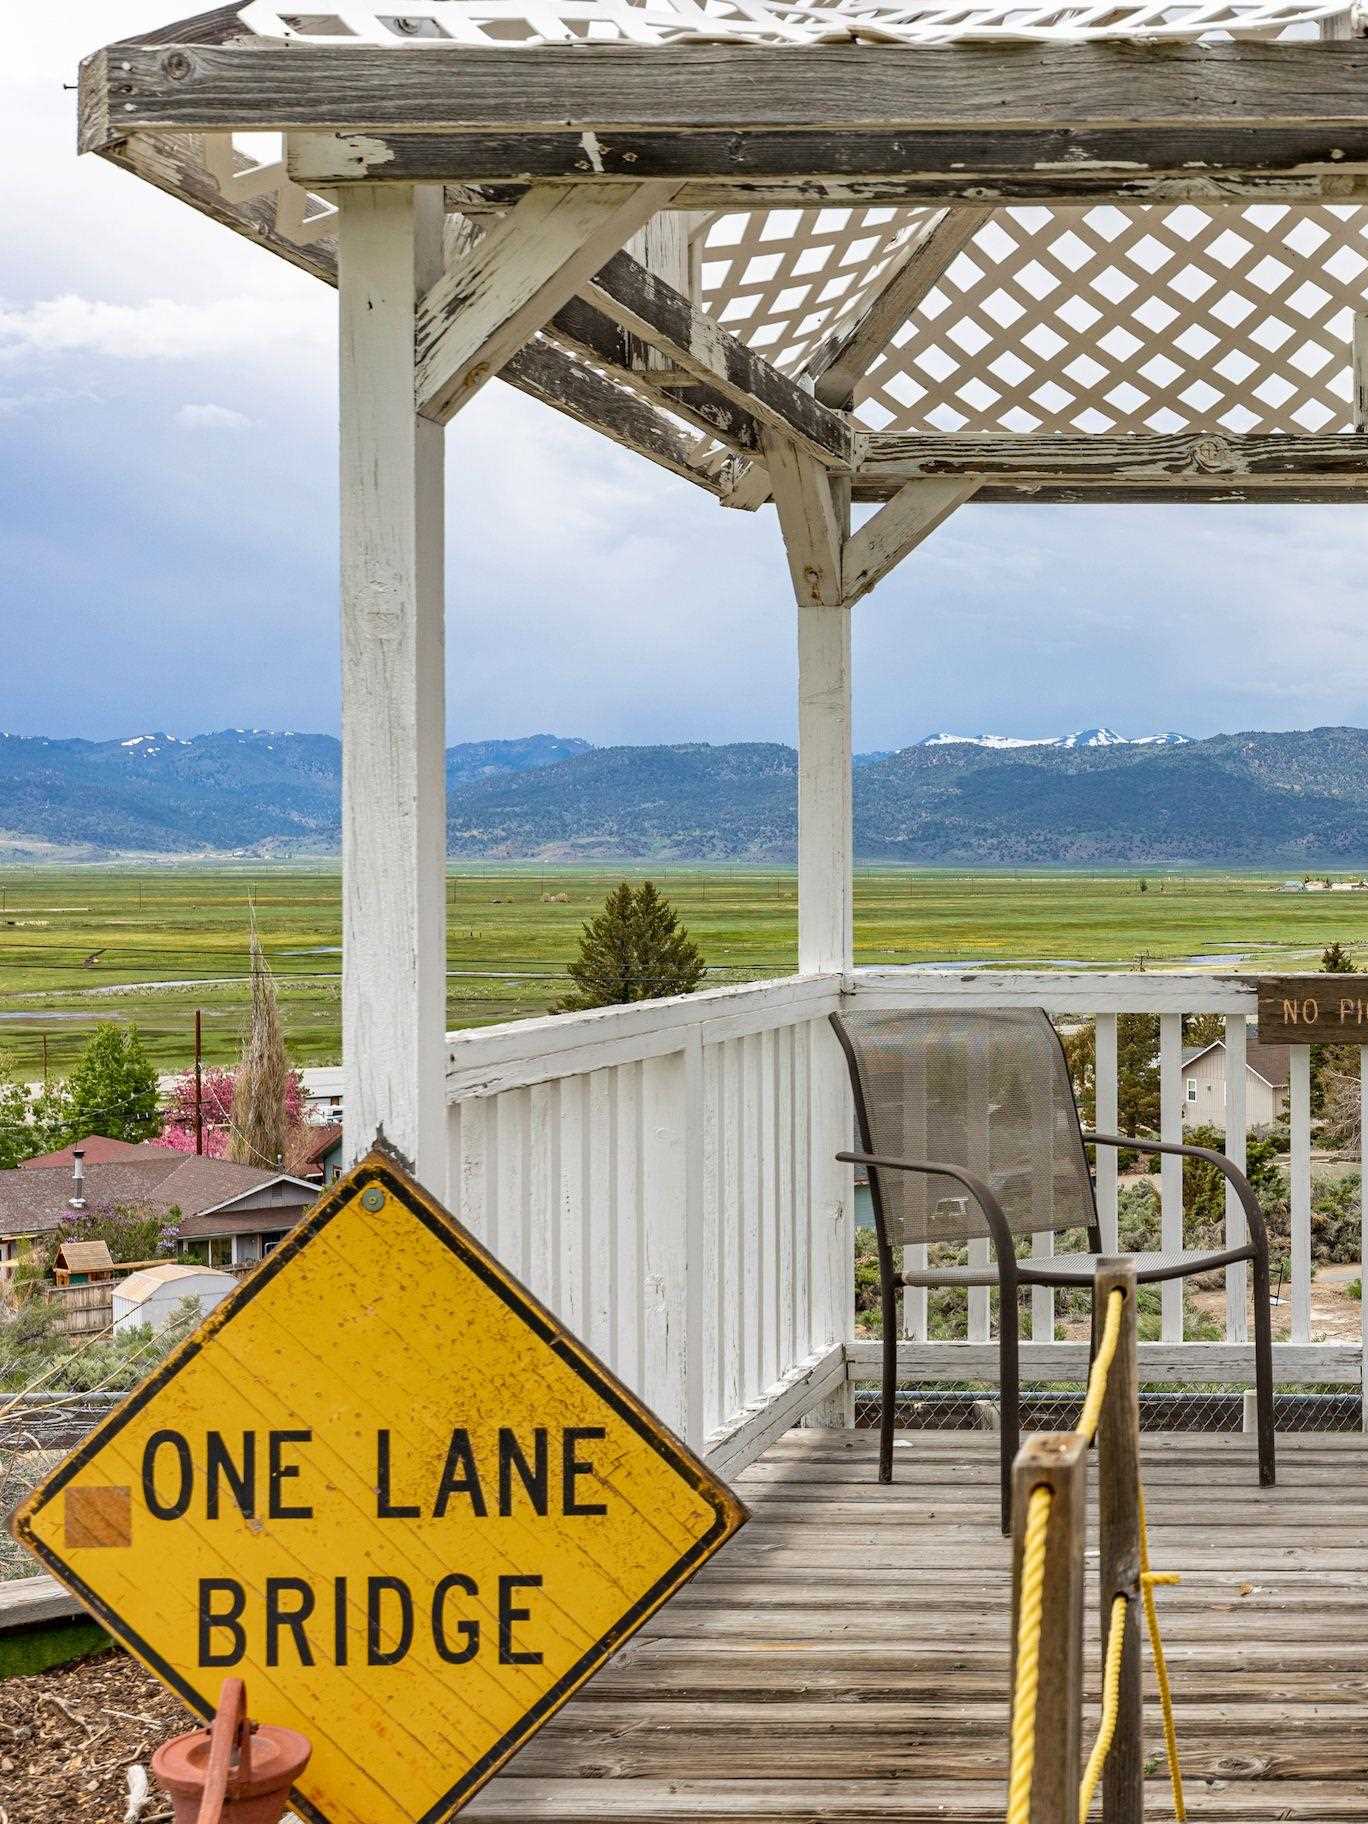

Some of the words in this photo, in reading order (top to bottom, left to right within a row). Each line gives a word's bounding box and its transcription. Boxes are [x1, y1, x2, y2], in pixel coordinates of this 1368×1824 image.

[1282, 998, 1318, 1025] NO
[142, 1428, 313, 1521] ONE
[376, 1427, 608, 1519] LANE
[198, 1574, 544, 1668] BRIDGE
